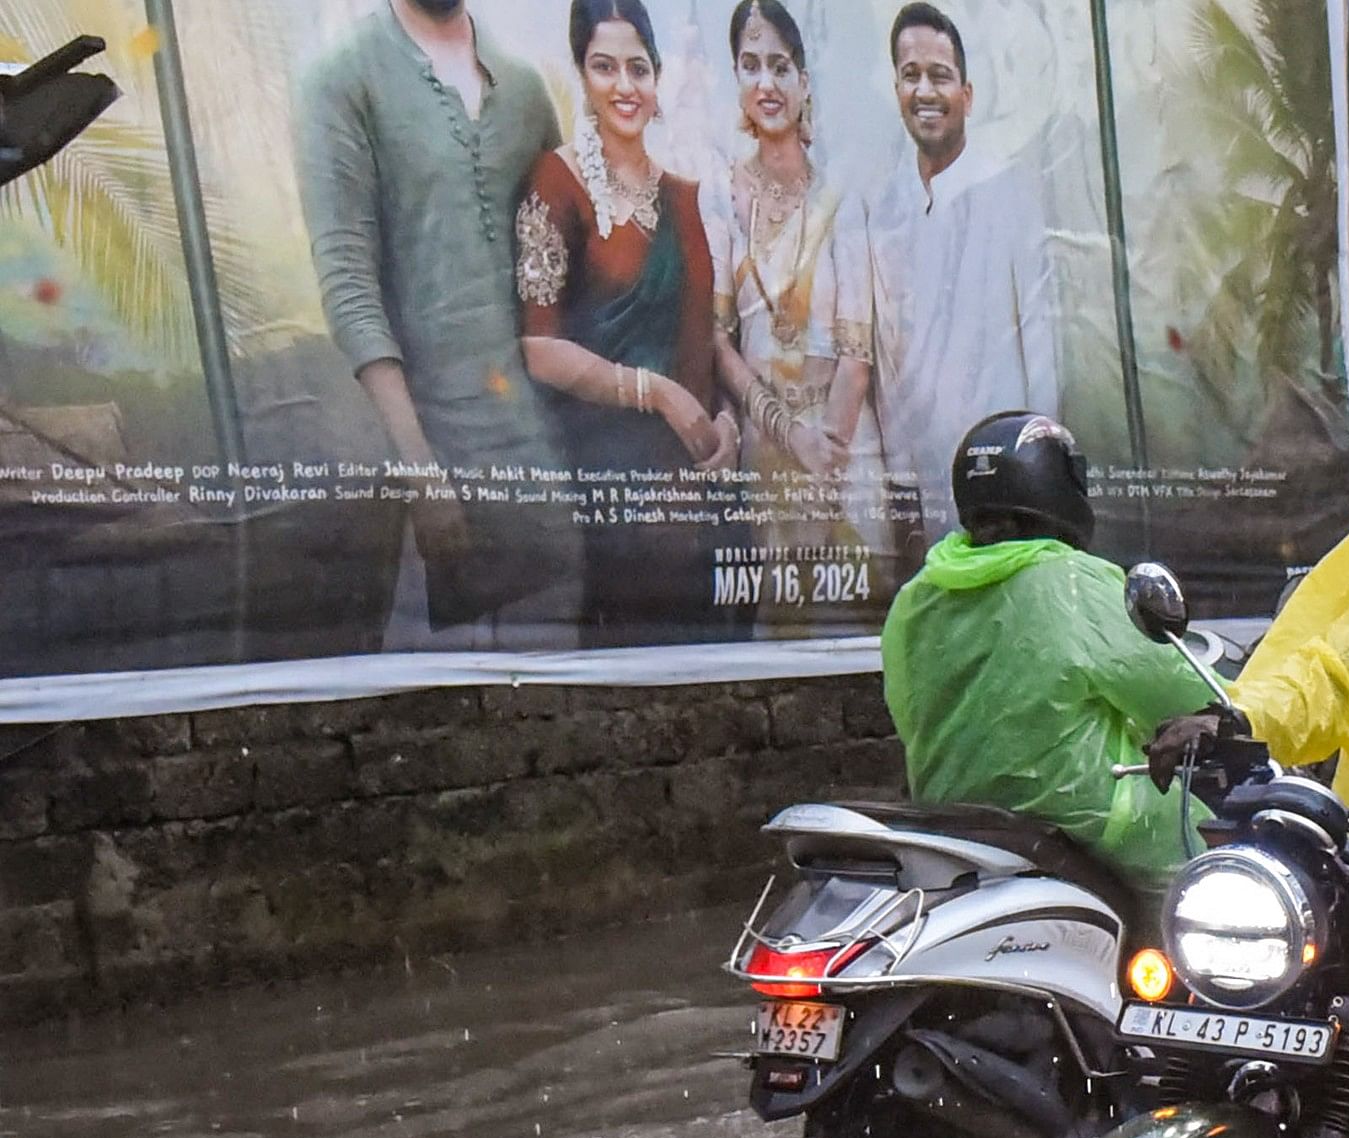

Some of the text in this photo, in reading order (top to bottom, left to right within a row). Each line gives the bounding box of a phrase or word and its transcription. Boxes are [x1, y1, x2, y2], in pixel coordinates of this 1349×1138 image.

[52, 463, 105, 486] Deepu
[115, 462, 185, 483] Pradeep
[192, 465, 220, 479] DOP
[228, 463, 284, 483] Neeraj
[294, 462, 330, 478] Revi
[338, 463, 379, 478] Editor
[491, 465, 526, 481] Ankit
[531, 465, 572, 482] Menon
[631, 468, 673, 482] Producer
[679, 466, 718, 482] Harris
[31, 489, 106, 505] Production
[111, 488, 181, 503] Controller
[189, 486, 236, 507] Rinny
[245, 484, 328, 502] Divakaran
[334, 485, 375, 500] Sound
[425, 485, 457, 500] Arun
[462, 484, 472, 501] S
[477, 486, 510, 502] Mani
[592, 488, 605, 502] M
[610, 488, 619, 503] R
[624, 487, 702, 507] Rajakrishnan
[594, 509, 605, 523] A
[609, 507, 618, 523] S
[623, 508, 666, 523] Dinesh
[723, 507, 774, 526] Catalyst
[715, 546, 789, 563] WORLDWIDE
[796, 546, 849, 562] RELEASE
[714, 562, 871, 608] MAY 16, 2024
[769, 1003, 826, 1030] KL 22
[1151, 1010, 1325, 1055] KL 43 P 5193
